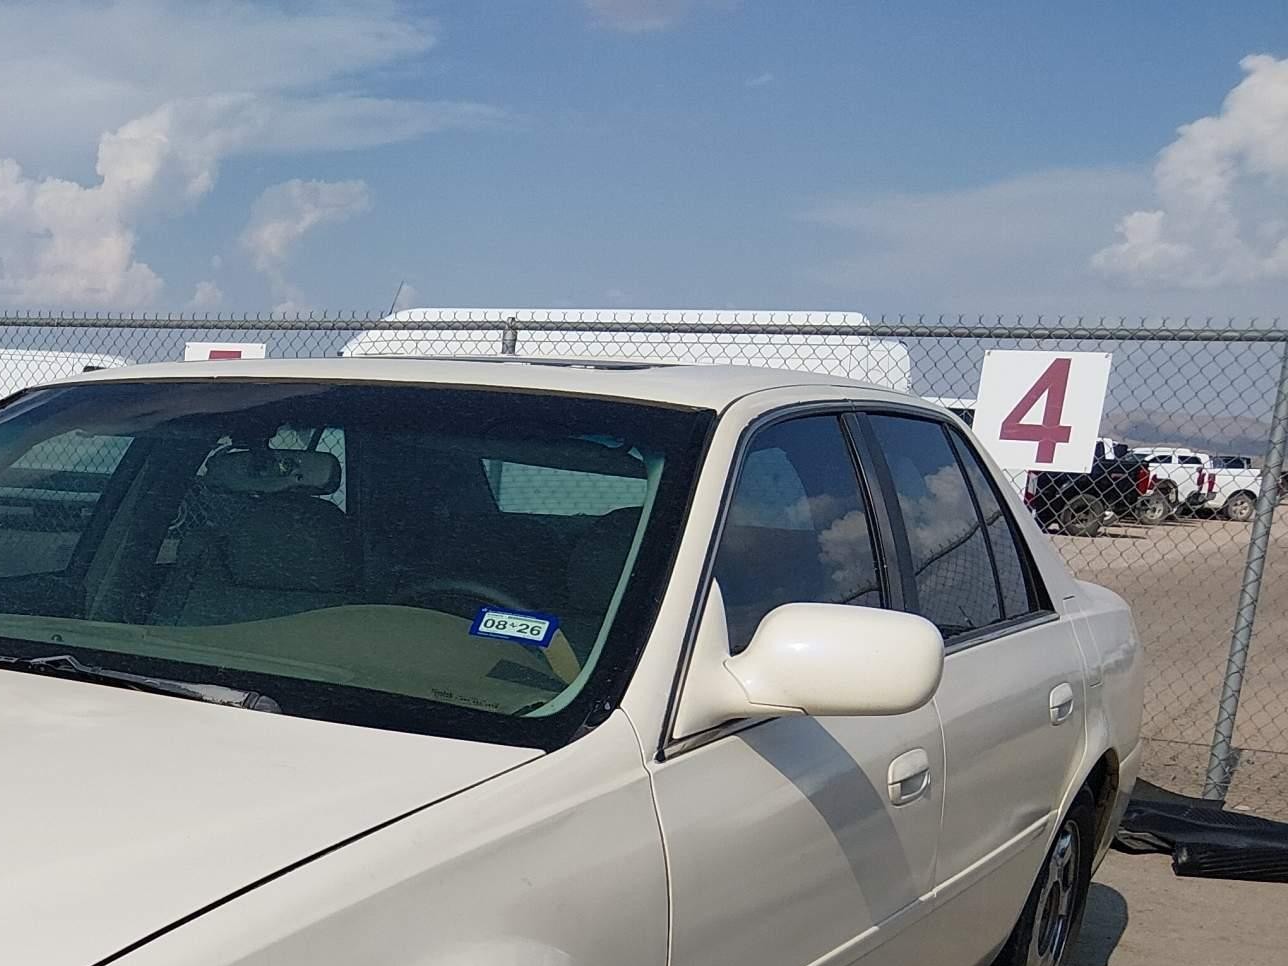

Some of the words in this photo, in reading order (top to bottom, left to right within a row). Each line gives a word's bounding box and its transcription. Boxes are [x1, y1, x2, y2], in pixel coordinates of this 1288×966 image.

[999, 358, 1073, 464] 4
[483, 618, 508, 630] 08
[516, 623, 542, 636] 26
